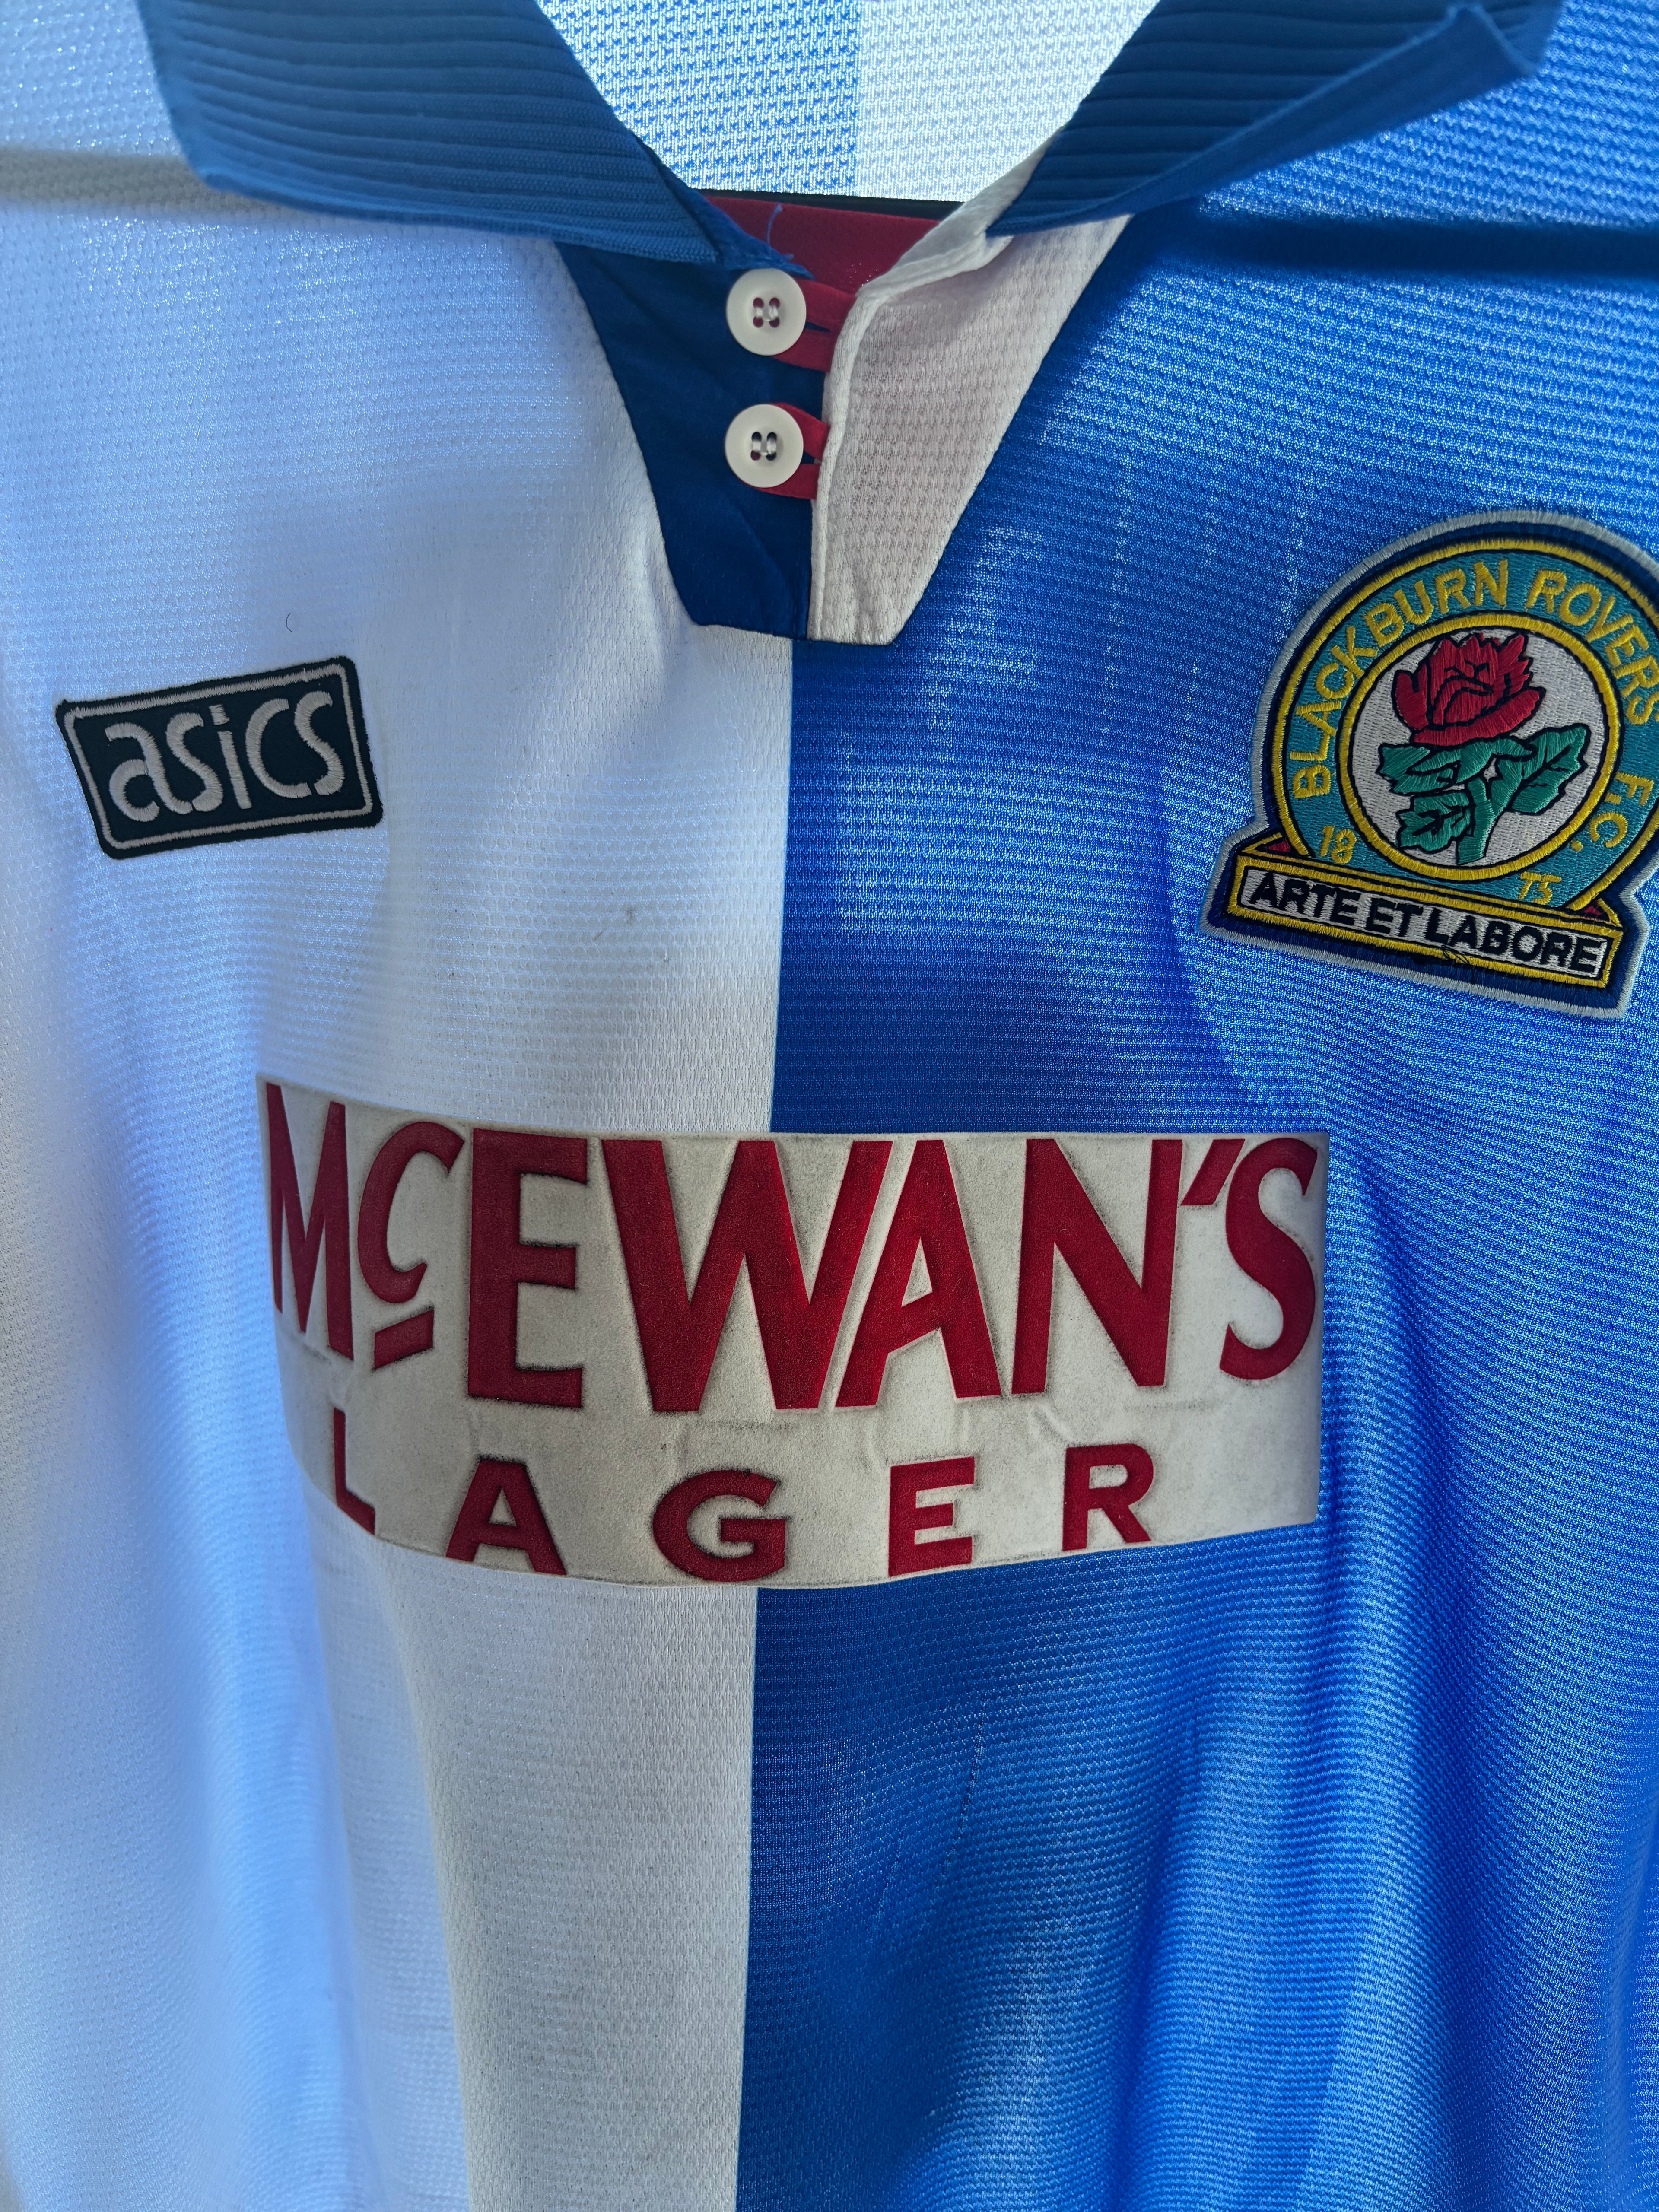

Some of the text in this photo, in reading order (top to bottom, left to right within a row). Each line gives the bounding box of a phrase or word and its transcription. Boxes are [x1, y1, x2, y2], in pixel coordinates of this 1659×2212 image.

[104, 690, 345, 823] asics
[1290, 559, 1659, 852] BLACKBURN ROVERS F.C.
[1249, 871, 1603, 973] ARTE ET LABORE
[1321, 824, 1562, 906] 18 75
[333, 1407, 1155, 1583] LAGER
